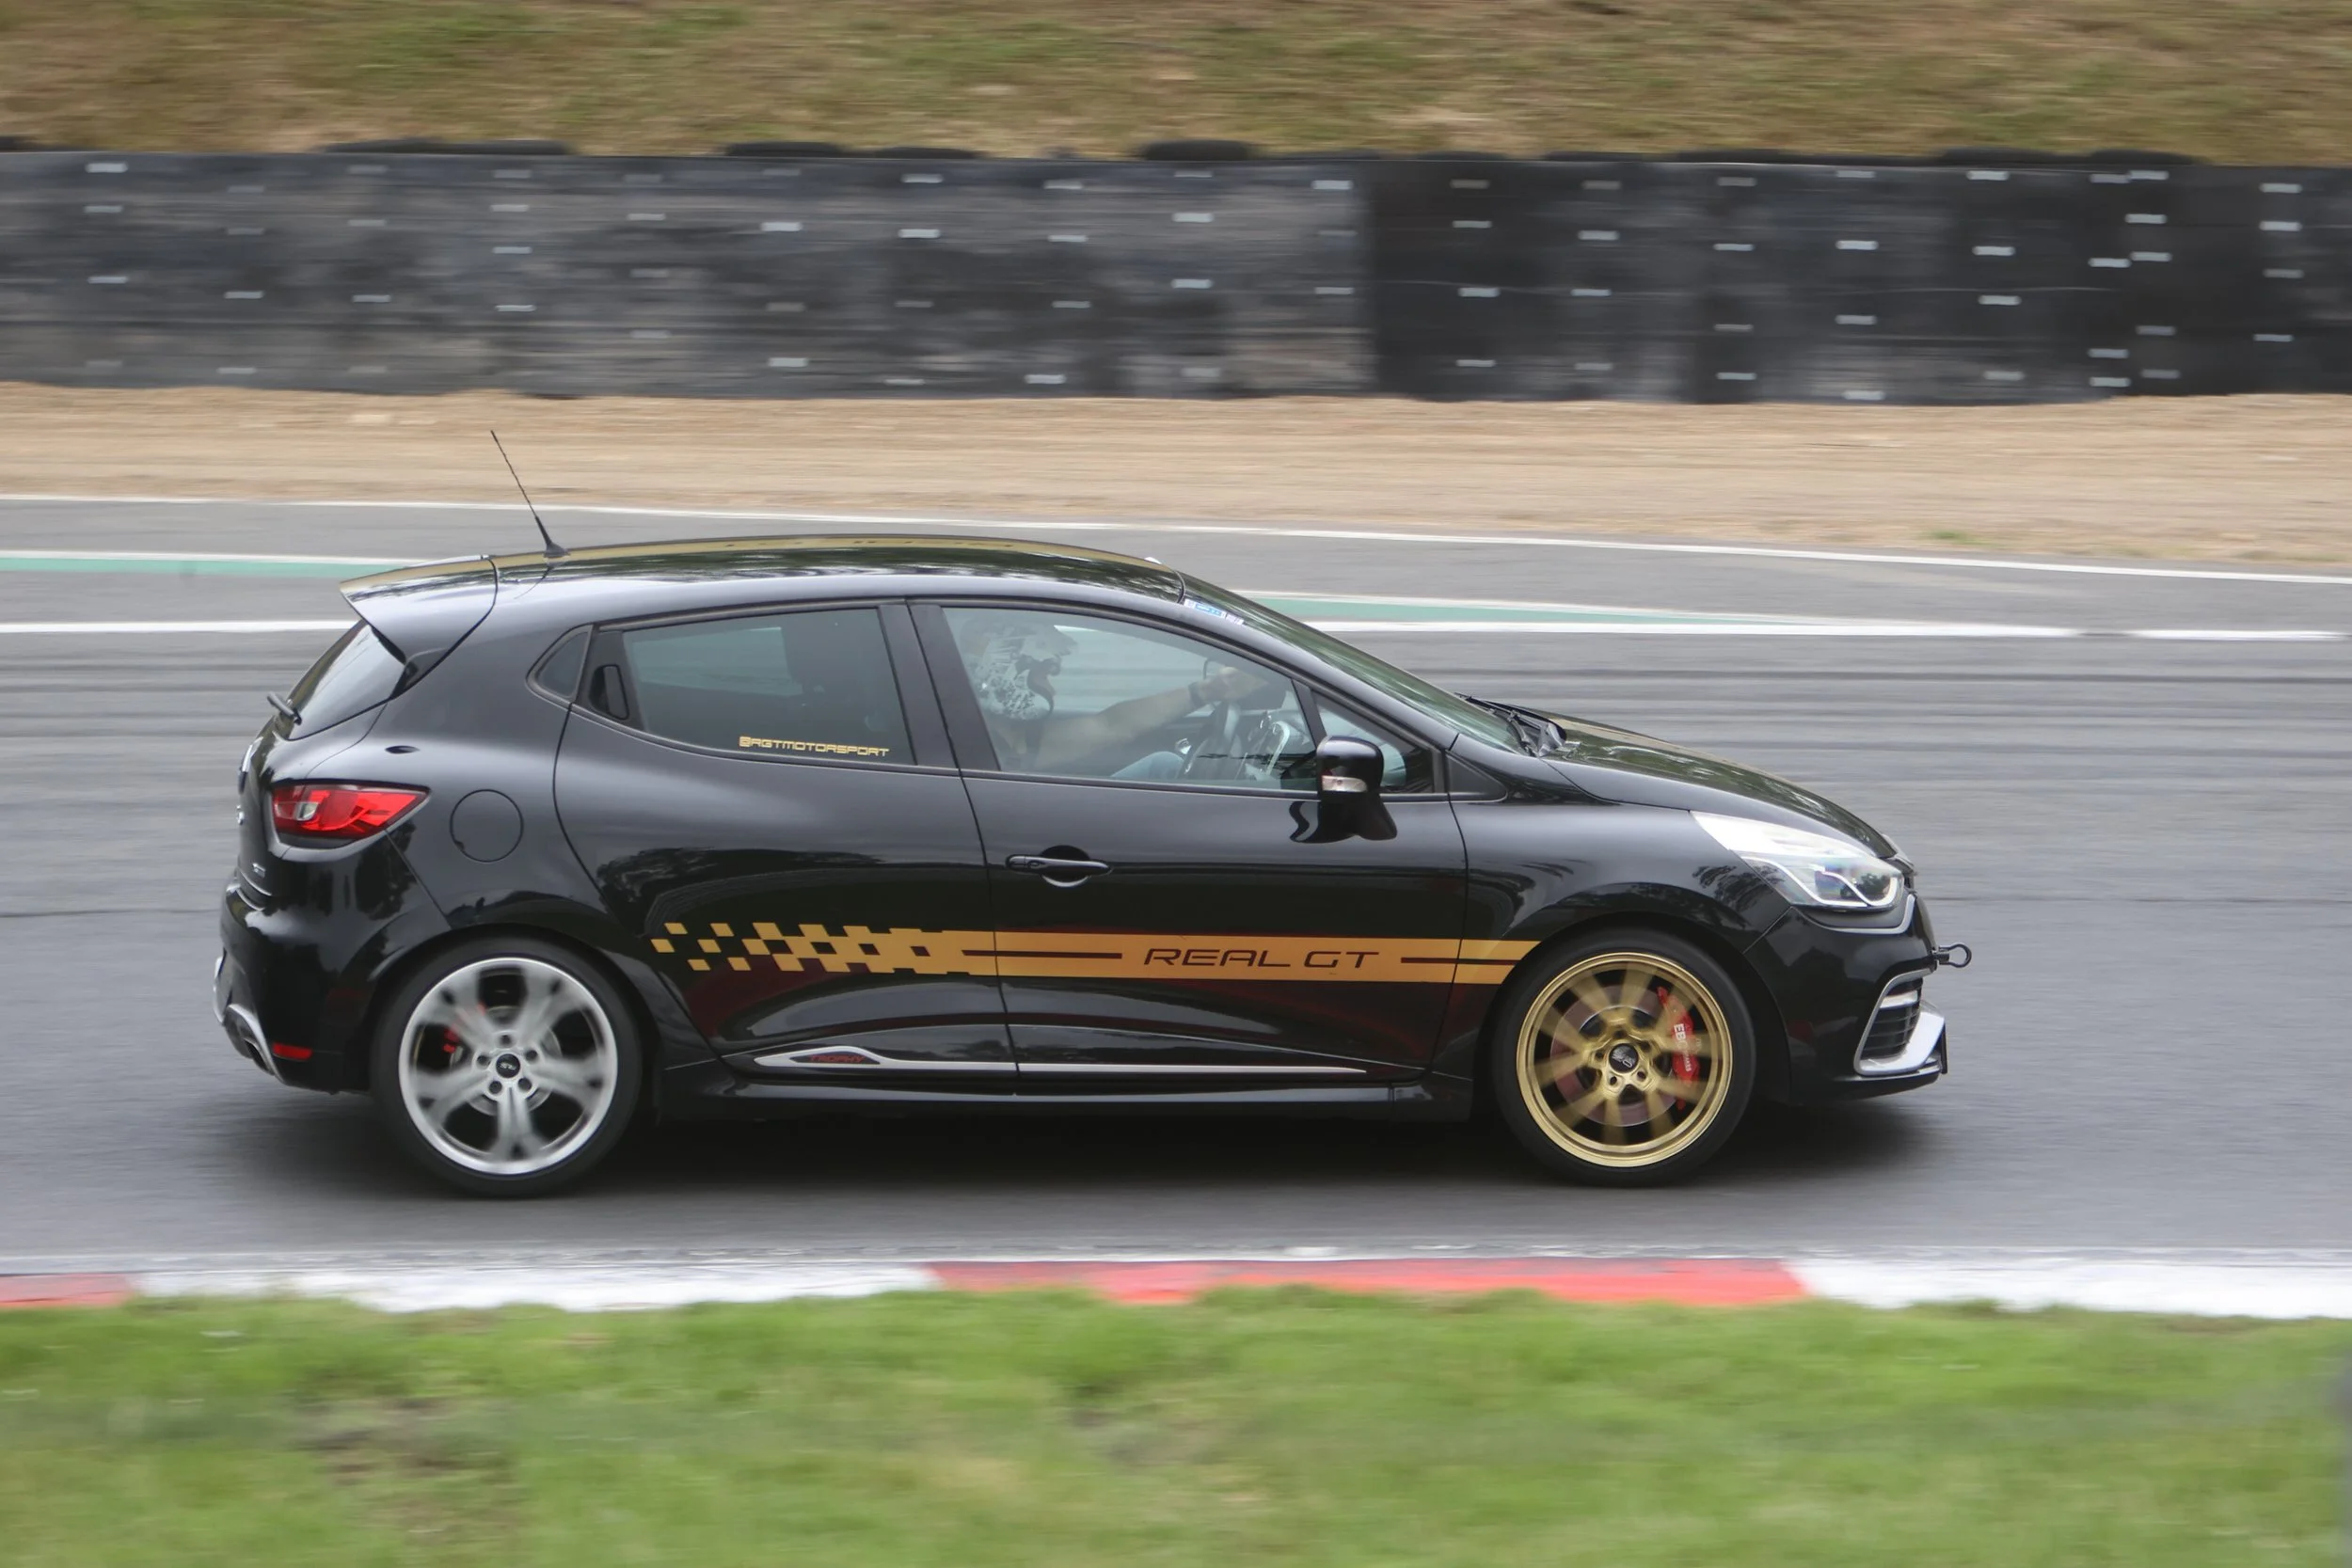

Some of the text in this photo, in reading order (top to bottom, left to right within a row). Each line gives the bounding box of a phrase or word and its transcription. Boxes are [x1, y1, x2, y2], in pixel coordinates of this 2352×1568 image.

[739, 736, 890, 757] @RGTMOTORSPORT
[1144, 948, 1379, 969] REAL GT
